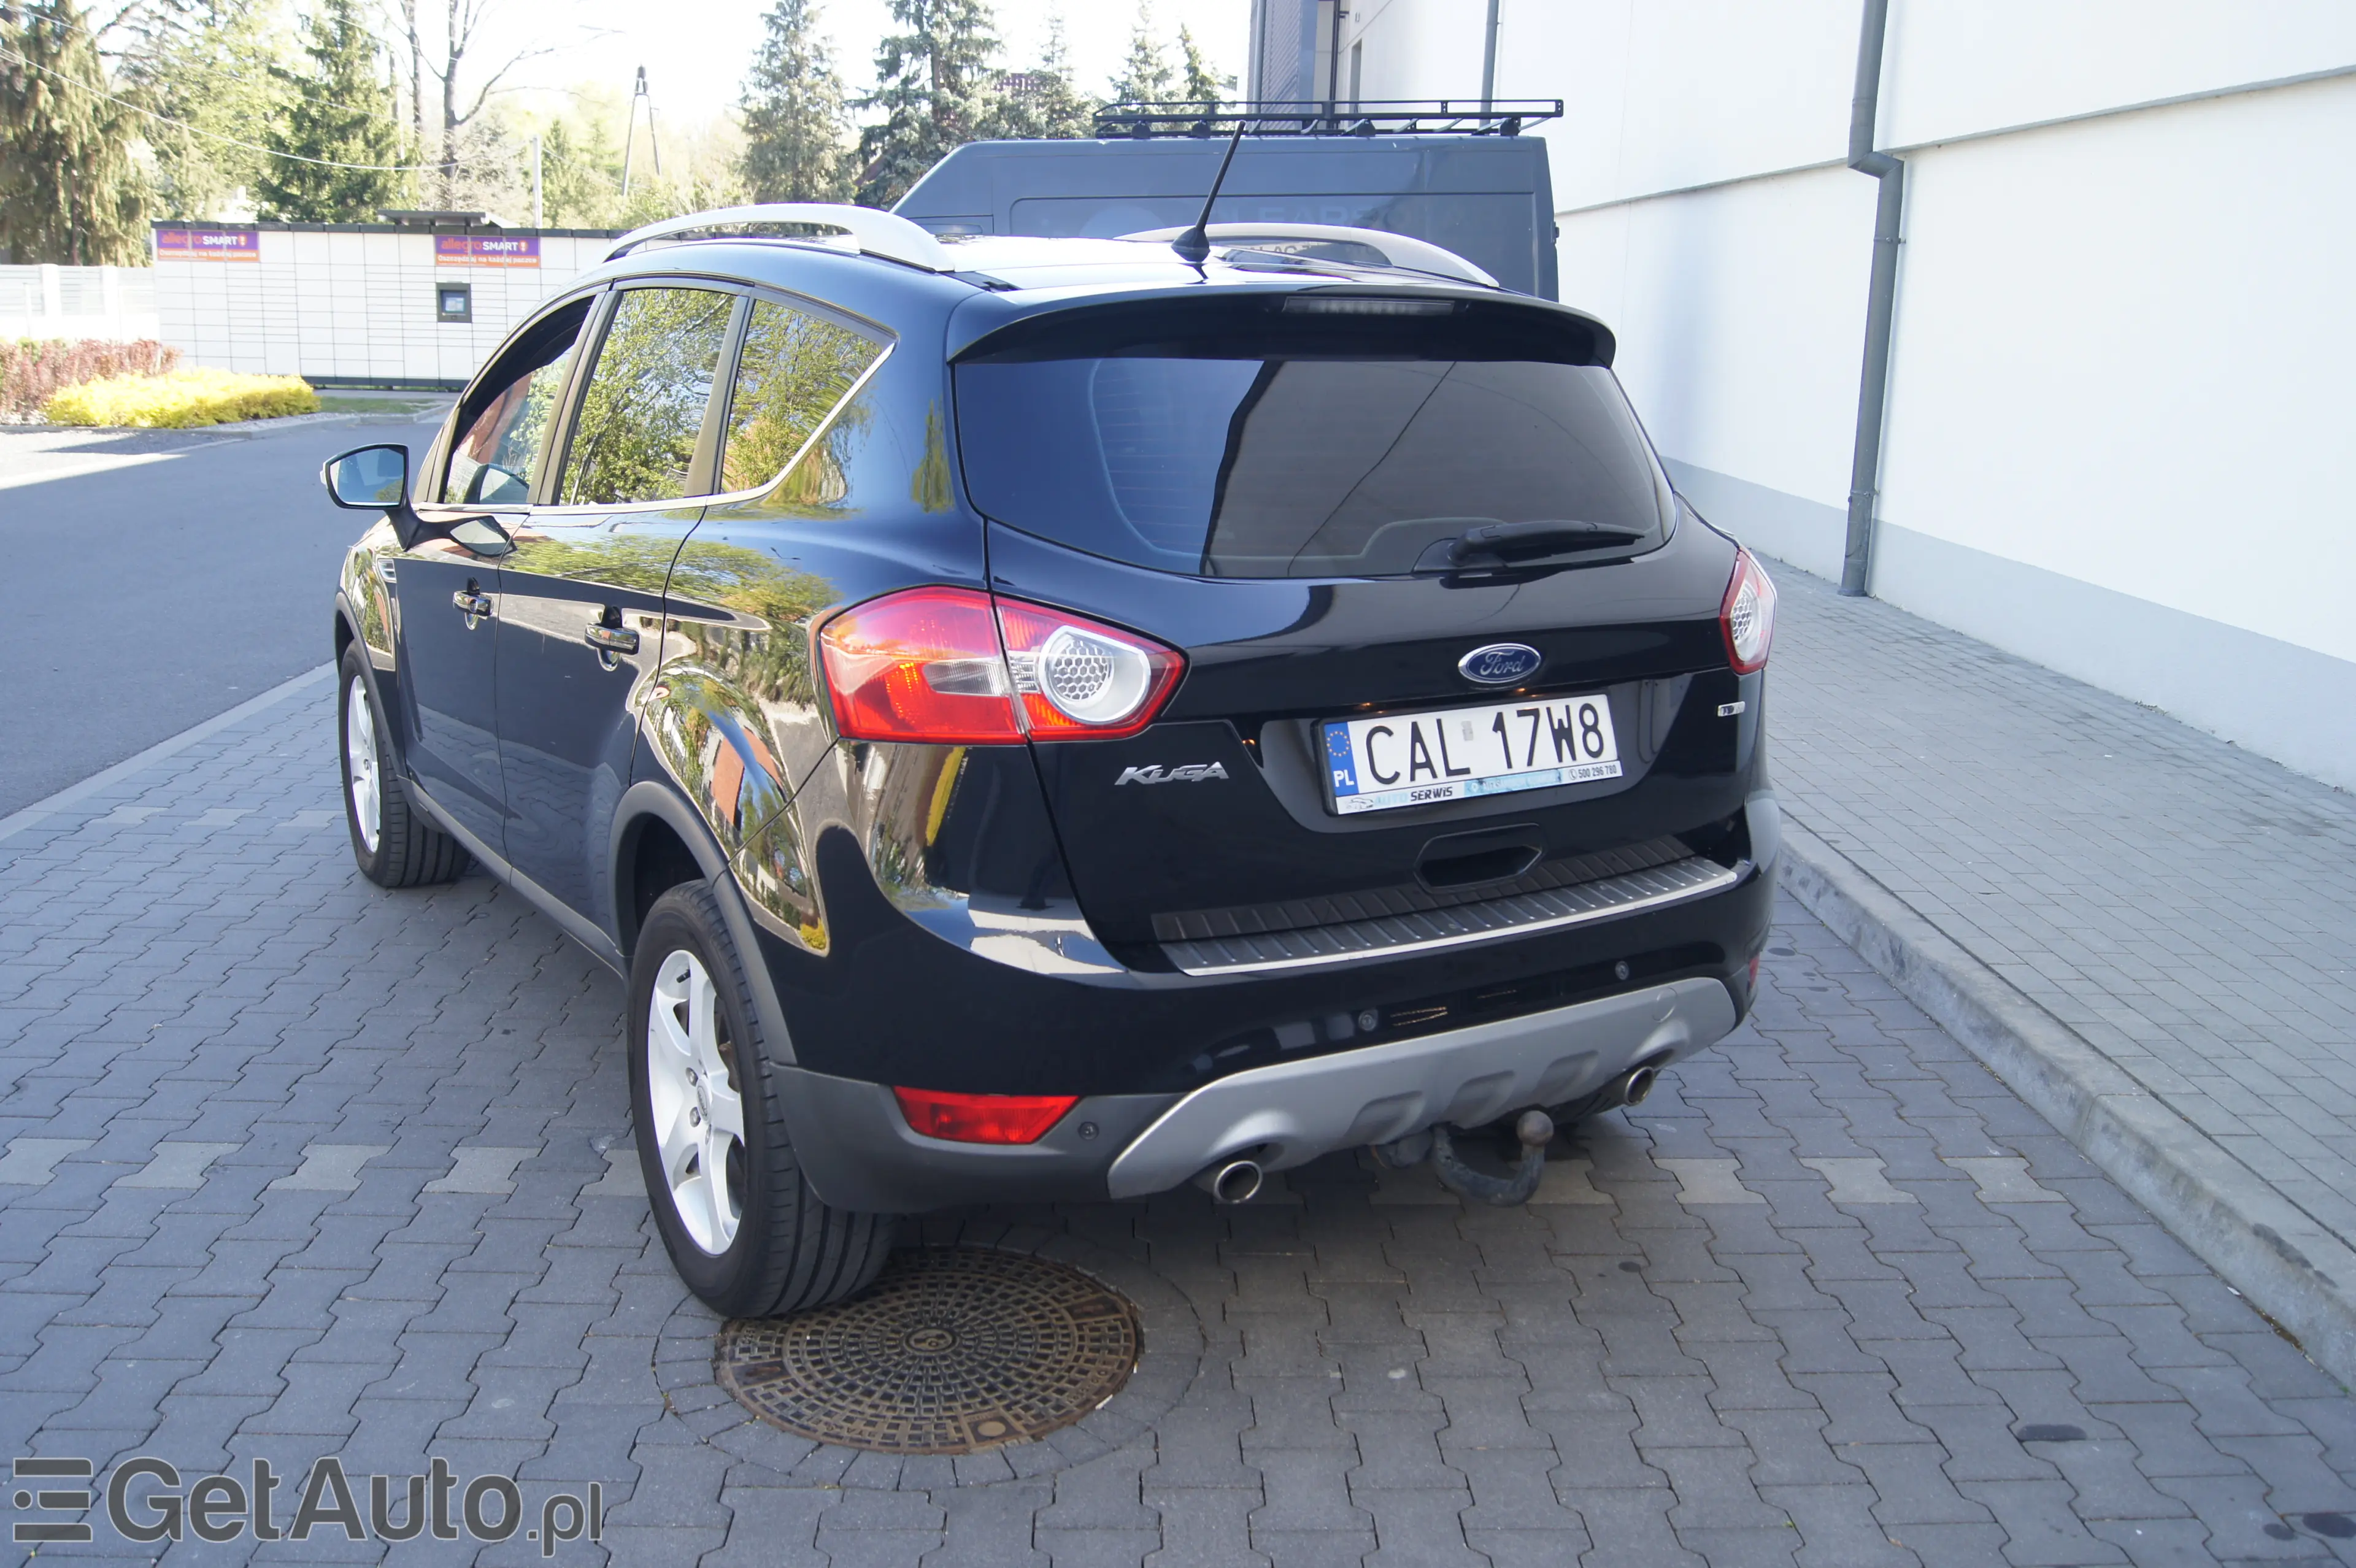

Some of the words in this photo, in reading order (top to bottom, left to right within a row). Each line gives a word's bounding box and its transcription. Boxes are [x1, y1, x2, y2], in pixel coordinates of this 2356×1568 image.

[1480, 651, 1526, 675] Ford
[1366, 718, 1471, 785] CAL
[1492, 703, 1604, 769] 17W8
[1114, 761, 1230, 785] KUGA
[1333, 769, 1355, 787] PL
